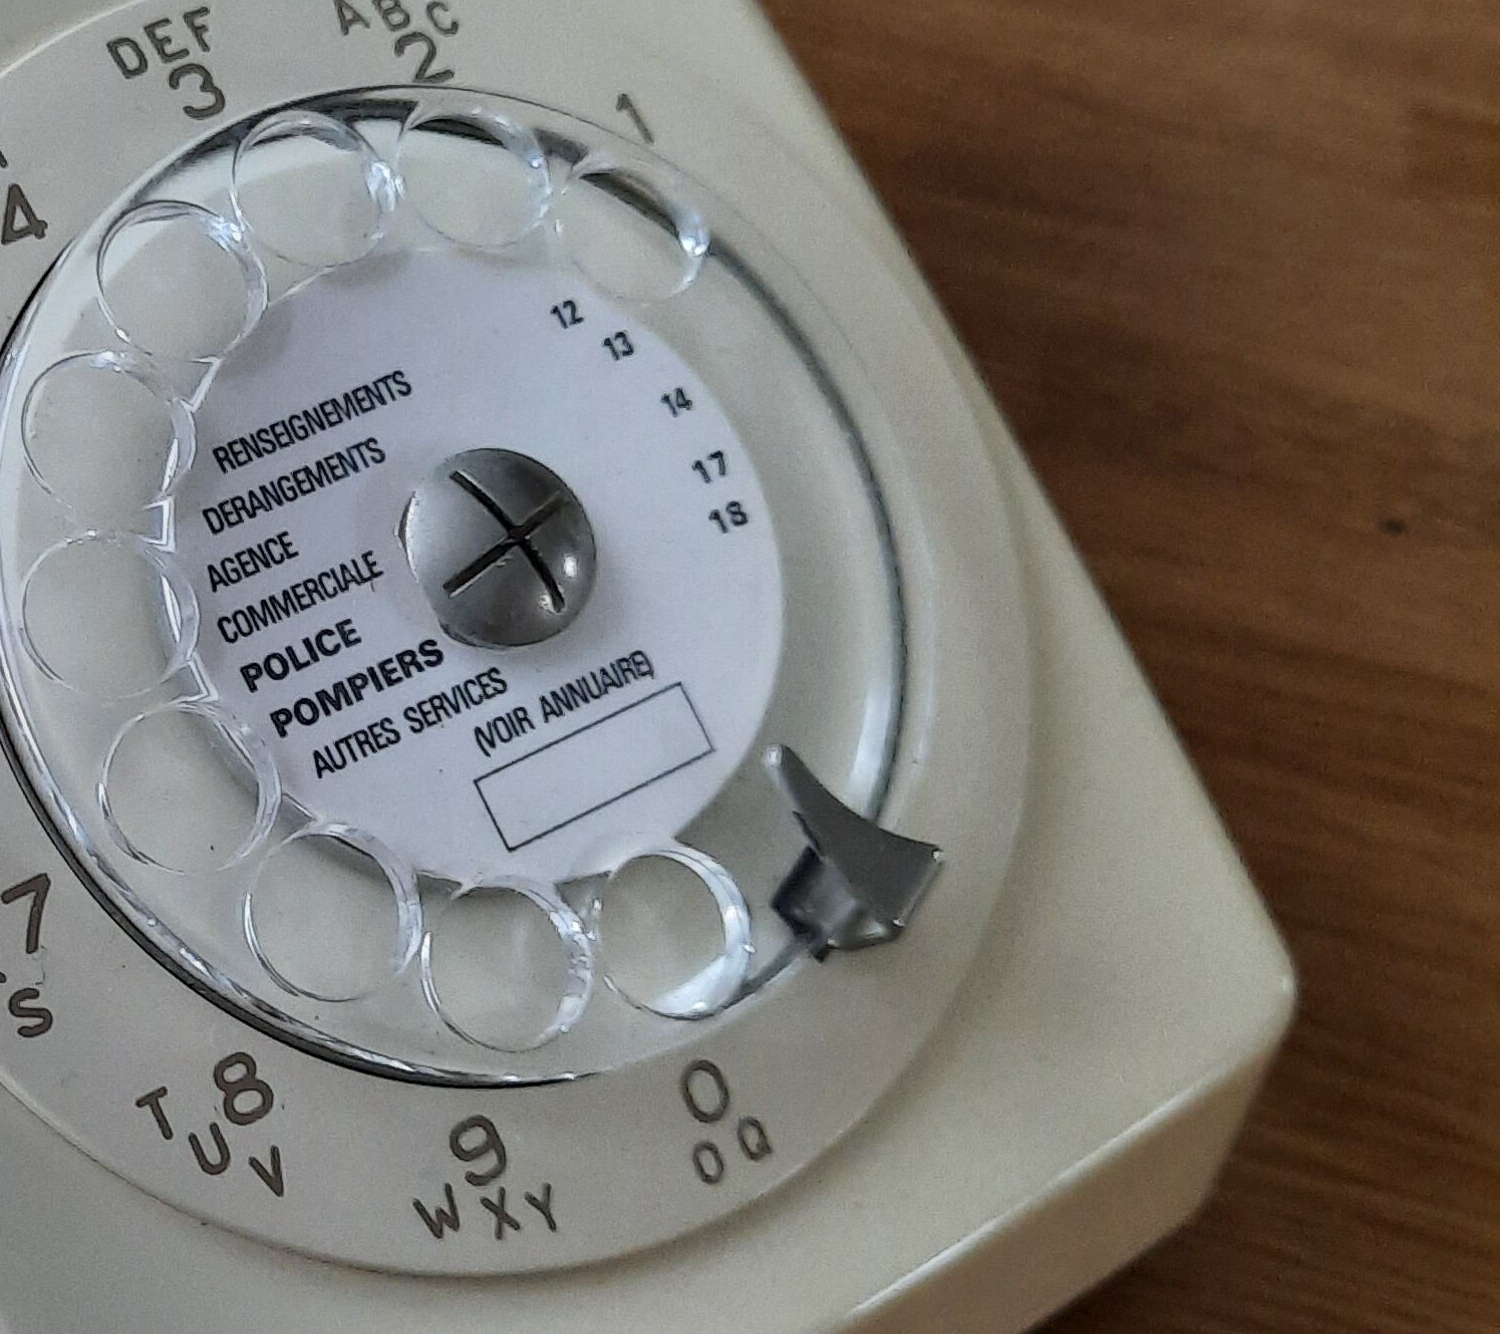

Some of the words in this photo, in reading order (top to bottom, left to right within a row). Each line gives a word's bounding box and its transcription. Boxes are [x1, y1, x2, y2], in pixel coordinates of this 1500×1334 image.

[393, 31, 455, 84] 2
[169, 64, 227, 120] 3
[614, 93, 655, 143] 1
[550, 300, 585, 328] 12
[603, 332, 635, 360] 13
[212, 371, 413, 473] RENSEIGNEMENTS
[660, 388, 693, 416] 14
[202, 437, 386, 535] DERANGEMENTS
[691, 451, 728, 484] 17
[707, 501, 748, 534] 18
[206, 531, 299, 592] AGENCE
[216, 551, 384, 644] COMMERCIALE
[239, 619, 362, 692] POLICE
[270, 638, 444, 736] POMPIERS
[312, 721, 400, 779] AUTRES
[409, 668, 507, 734] SERVICES
[473, 706, 536, 757] (VOIR
[538, 650, 655, 723] ANNUAIRE)
[0, 873, 52, 955] 7
[214, 1051, 276, 1126] 8
[681, 1060, 731, 1124] 0
[448, 1114, 509, 1187] 9
